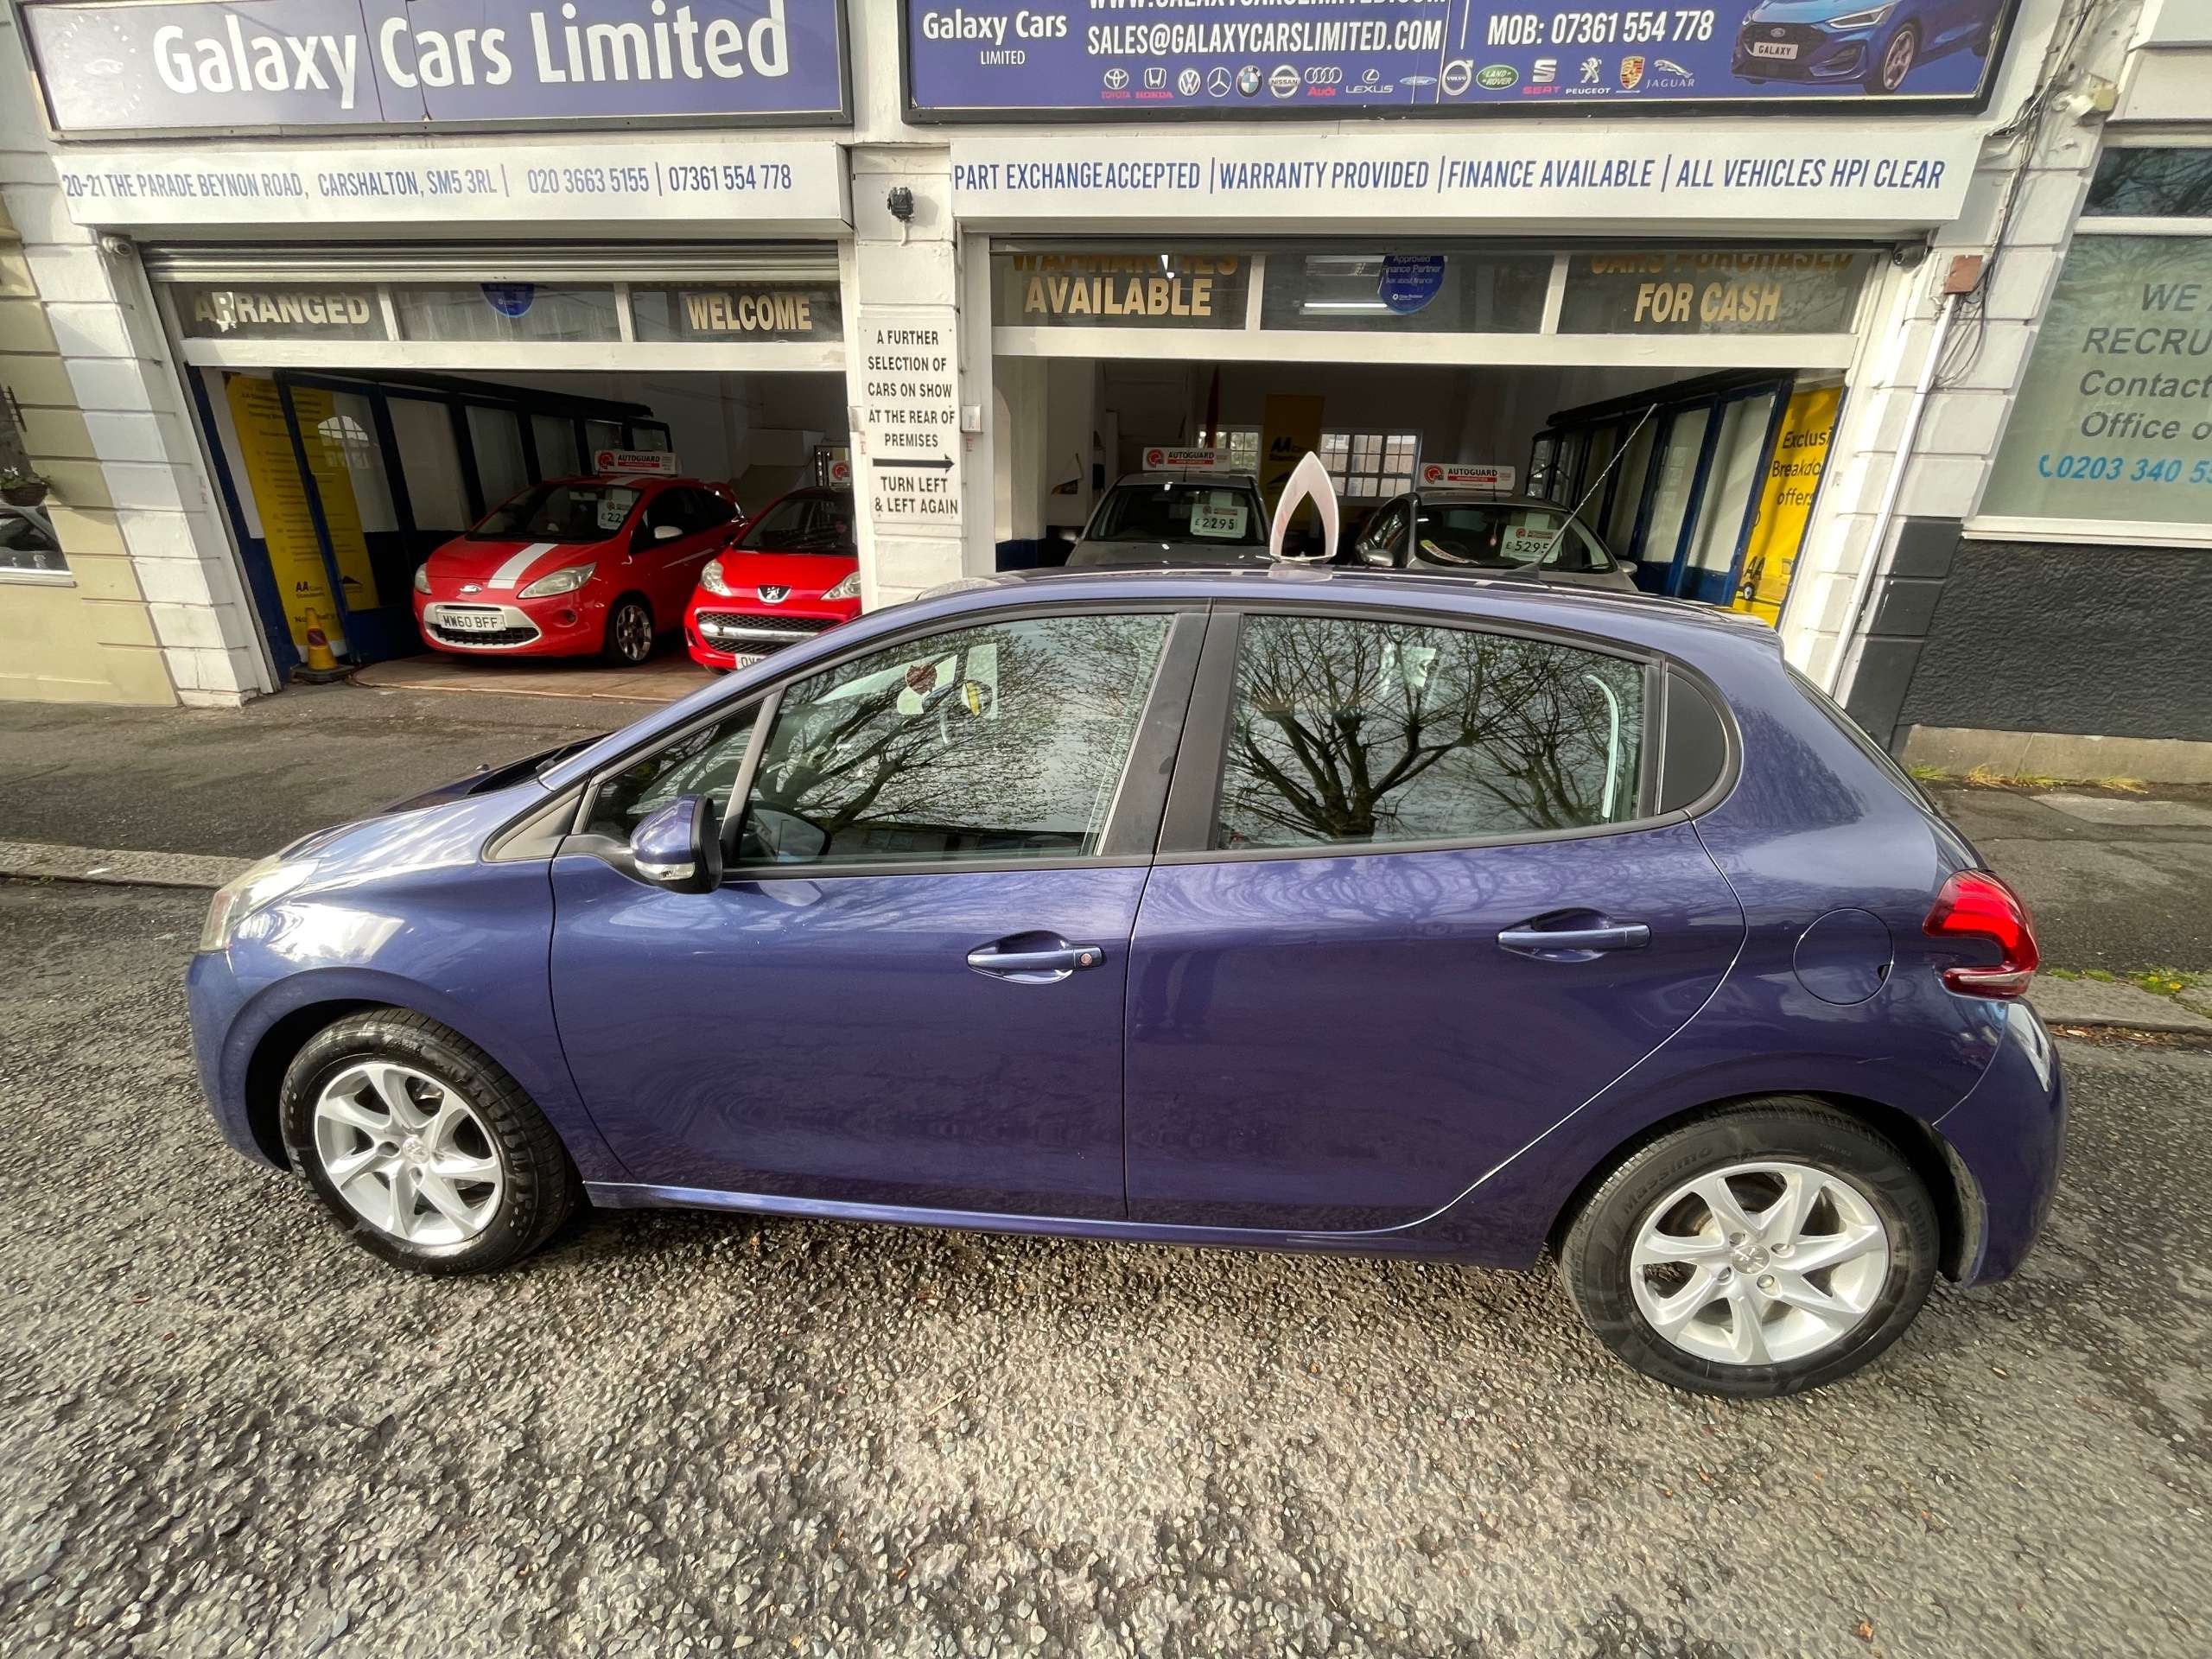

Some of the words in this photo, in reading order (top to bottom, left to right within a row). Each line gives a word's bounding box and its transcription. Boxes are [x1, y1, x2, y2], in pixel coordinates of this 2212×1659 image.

[923, 9, 1007, 46] Galaxy
[1016, 11, 1068, 38] Cars
[1087, 20, 1443, 56] SALES@GALAXYCARSLIMITED.COM
[1487, 15, 1545, 46] MOB:
[1550, 12, 1618, 44] 07361
[1623, 11, 1668, 42] 554
[1673, 10, 1715, 41] 778
[153, 14, 357, 110] Galaxy
[380, 16, 512, 88] Cars
[531, 0, 790, 84] Limited
[980, 49, 1027, 66] LIMITED
[1758, 45, 1791, 56] GALAXY
[1485, 68, 1507, 78] LAND
[1486, 77, 1512, 86] ROVER
[1646, 78, 1695, 89] JAGUAR
[1307, 86, 1337, 97] Audi
[1345, 85, 1394, 94] LEXUS
[1522, 86, 1561, 95] SEAT
[62, 174, 105, 197] 20-21
[105, 174, 137, 197] THE
[137, 173, 197, 197] PARADE
[197, 173, 259, 197] BEYNON
[260, 173, 309, 200] ROAD,
[318, 171, 425, 199] CARSHALTON,
[426, 169, 463, 194] SM5
[465, 168, 498, 194] 3RL
[527, 168, 560, 194] 020
[563, 168, 607, 193] 3663
[609, 167, 650, 192] 5155
[668, 165, 720, 191] 07361
[723, 165, 757, 190] 554
[760, 164, 792, 190] 778
[954, 164, 999, 191] PART
[1007, 162, 1103, 190] EXCHANGE
[1105, 162, 1201, 189] ACCEPTED
[1219, 161, 1327, 189] WARRANTY
[1332, 160, 1430, 189] PROVIDED
[1447, 160, 1536, 188] FINANCE
[1540, 159, 1656, 188] AVAILABLE
[1675, 159, 1715, 188] ALL
[1724, 158, 1825, 188] VEHICLES
[1829, 159, 1869, 188] HPI
[1872, 159, 1947, 189] CLEAR
[194, 290, 372, 325] ARRANGED
[1024, 276, 1213, 316] AVAILABLE
[1633, 282, 1694, 323] FOR
[1700, 281, 1782, 323] CASH
[2141, 283, 2202, 312] WE
[686, 294, 812, 330] WELCOME
[877, 329, 884, 345] A
[887, 330, 938, 345] FURTHER
[868, 355, 929, 372] SELECTION
[933, 357, 947, 372] OF
[868, 382, 897, 397] CARS
[900, 383, 916, 397] ON
[919, 383, 952, 397] SHOW
[869, 409, 881, 423] AT
[884, 410, 906, 423] THE
[909, 410, 938, 424] REAR
[941, 410, 955, 424] OF
[2081, 410, 2182, 440] Office
[884, 433, 938, 448] PREMISES
[1168, 450, 1215, 459] AUTOGUARD
[2056, 455, 2124, 480] 0203
[2129, 458, 2183, 483] 340
[880, 476, 914, 493] TURN
[918, 477, 948, 493] LEFT
[874, 497, 883, 512] &
[887, 498, 916, 512] LEFT
[920, 499, 958, 514] AGAIN
[1744, 556, 1766, 581] AA
[296, 582, 309, 592] AA
